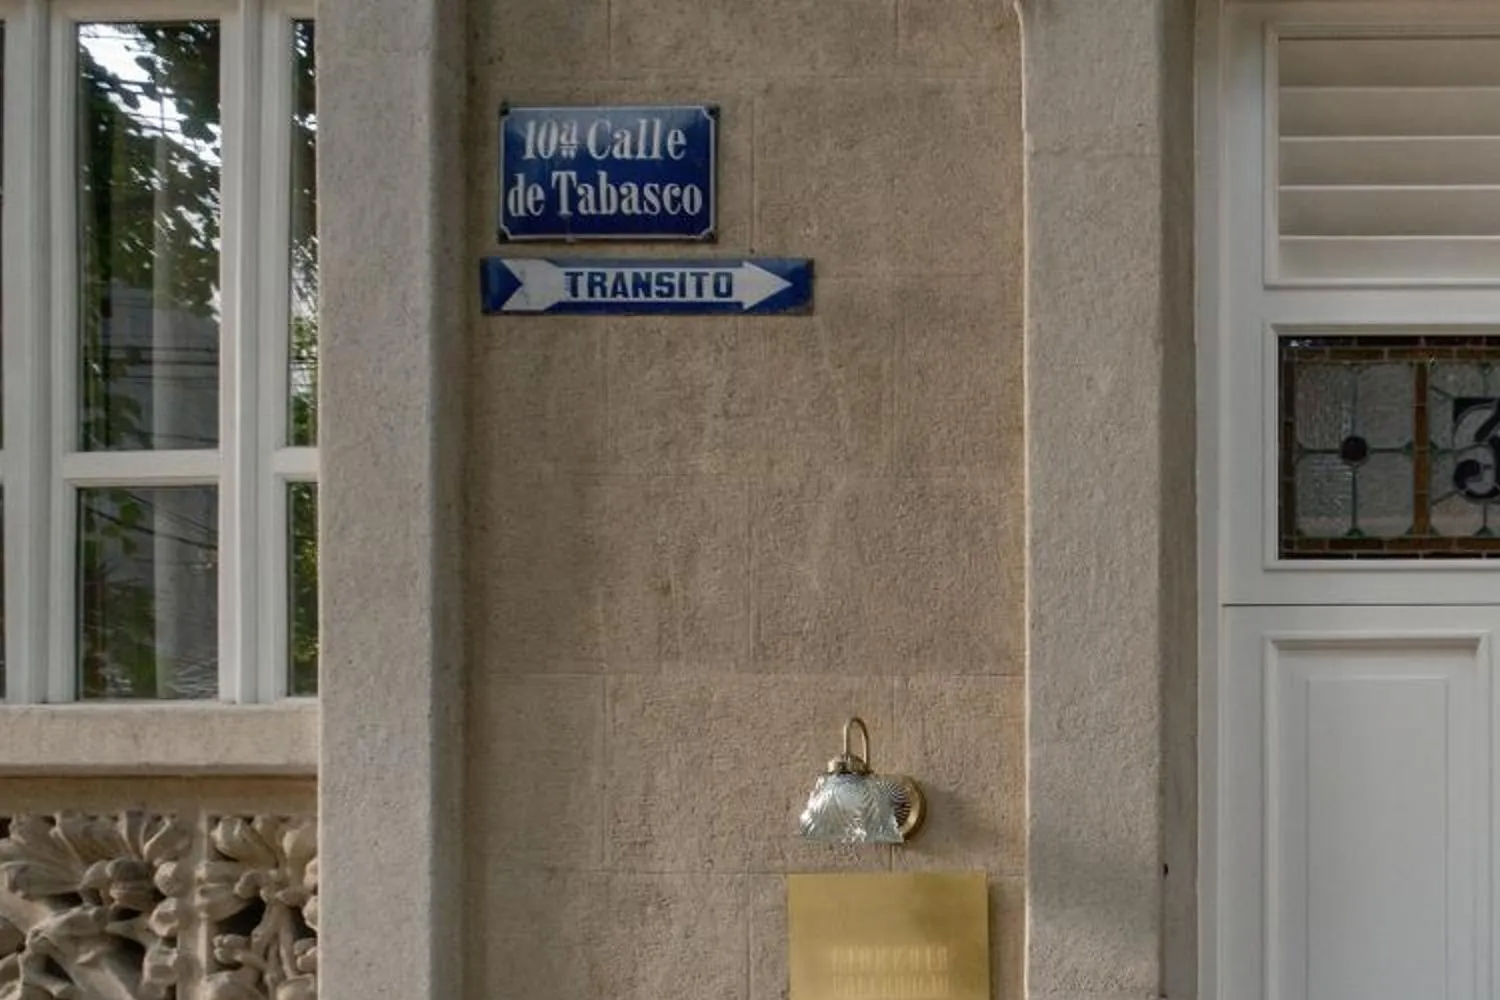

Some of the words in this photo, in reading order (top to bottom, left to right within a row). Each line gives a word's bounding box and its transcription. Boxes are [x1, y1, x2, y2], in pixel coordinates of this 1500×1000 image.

[587, 117, 688, 160] Calle
[507, 173, 545, 217] de
[551, 170, 704, 217] Tabasco
[564, 270, 734, 299] TRANSITO
